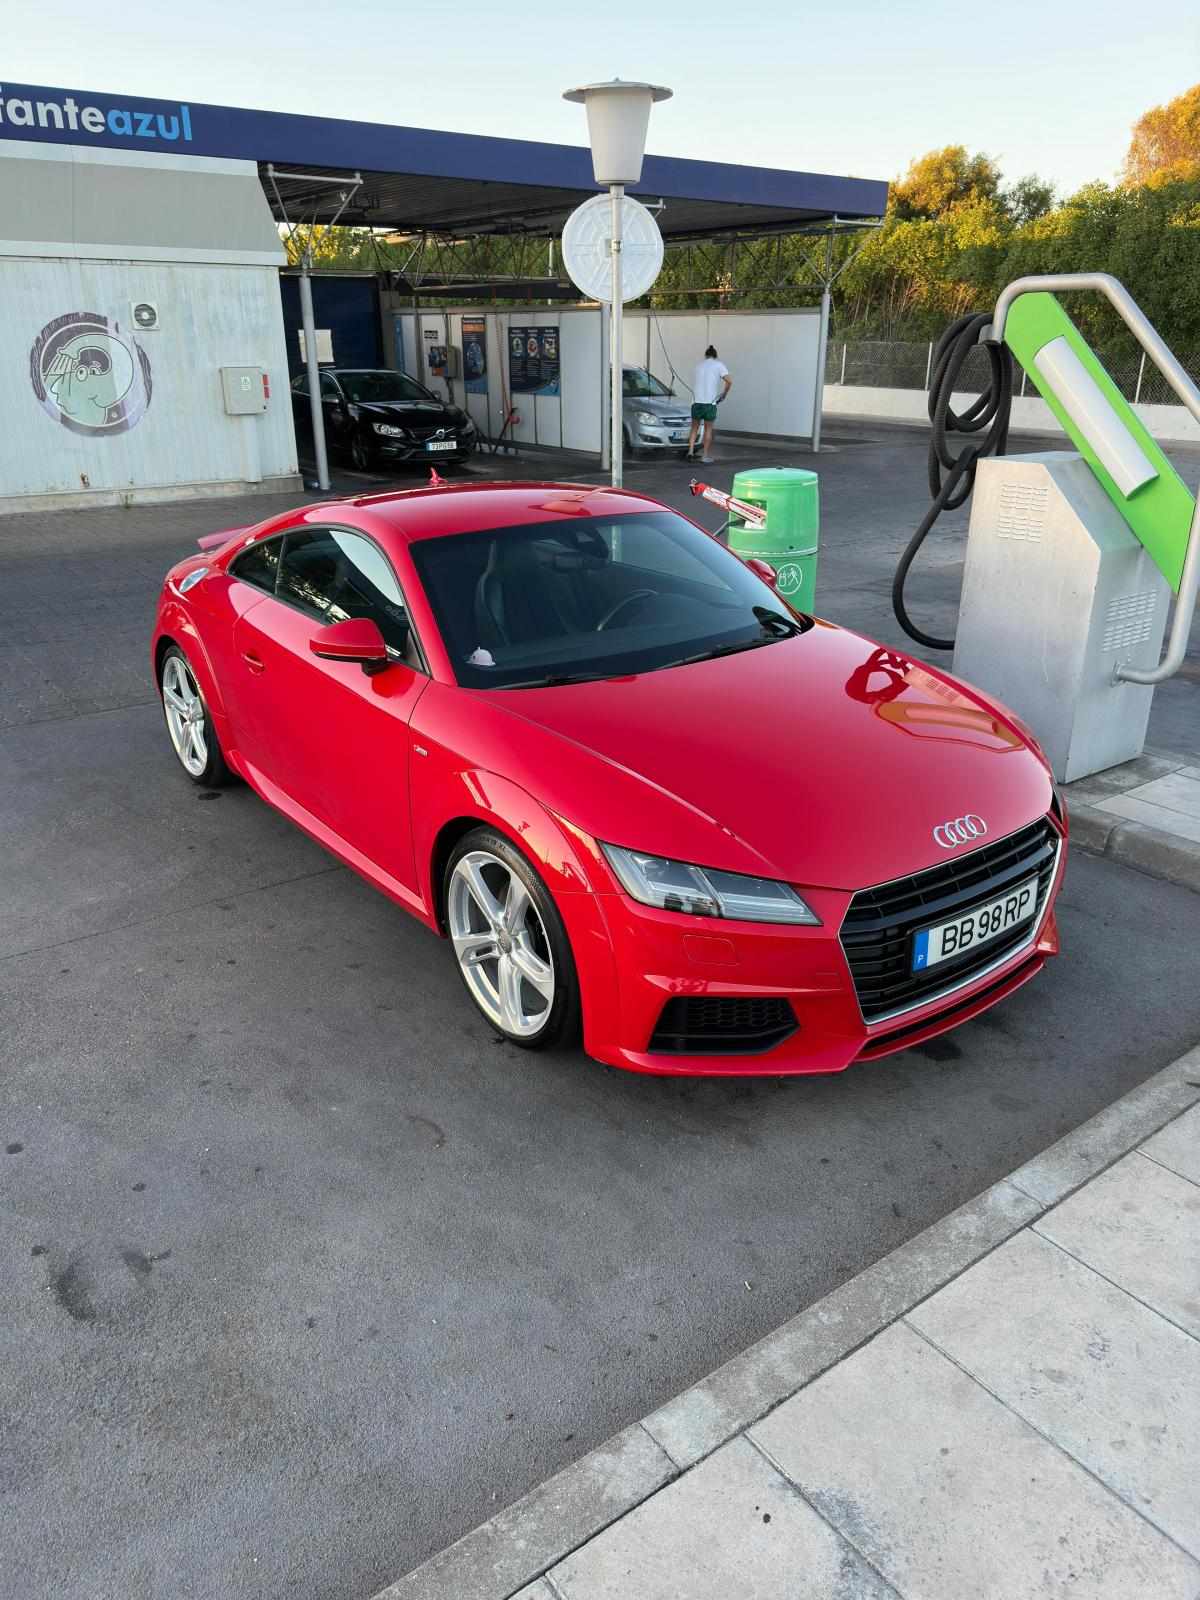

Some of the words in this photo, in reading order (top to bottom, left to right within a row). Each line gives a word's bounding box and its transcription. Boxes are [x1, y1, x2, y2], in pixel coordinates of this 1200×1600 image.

[941, 917, 975, 956] BB
[978, 905, 1002, 939] 98
[1004, 889, 1031, 927] RP
